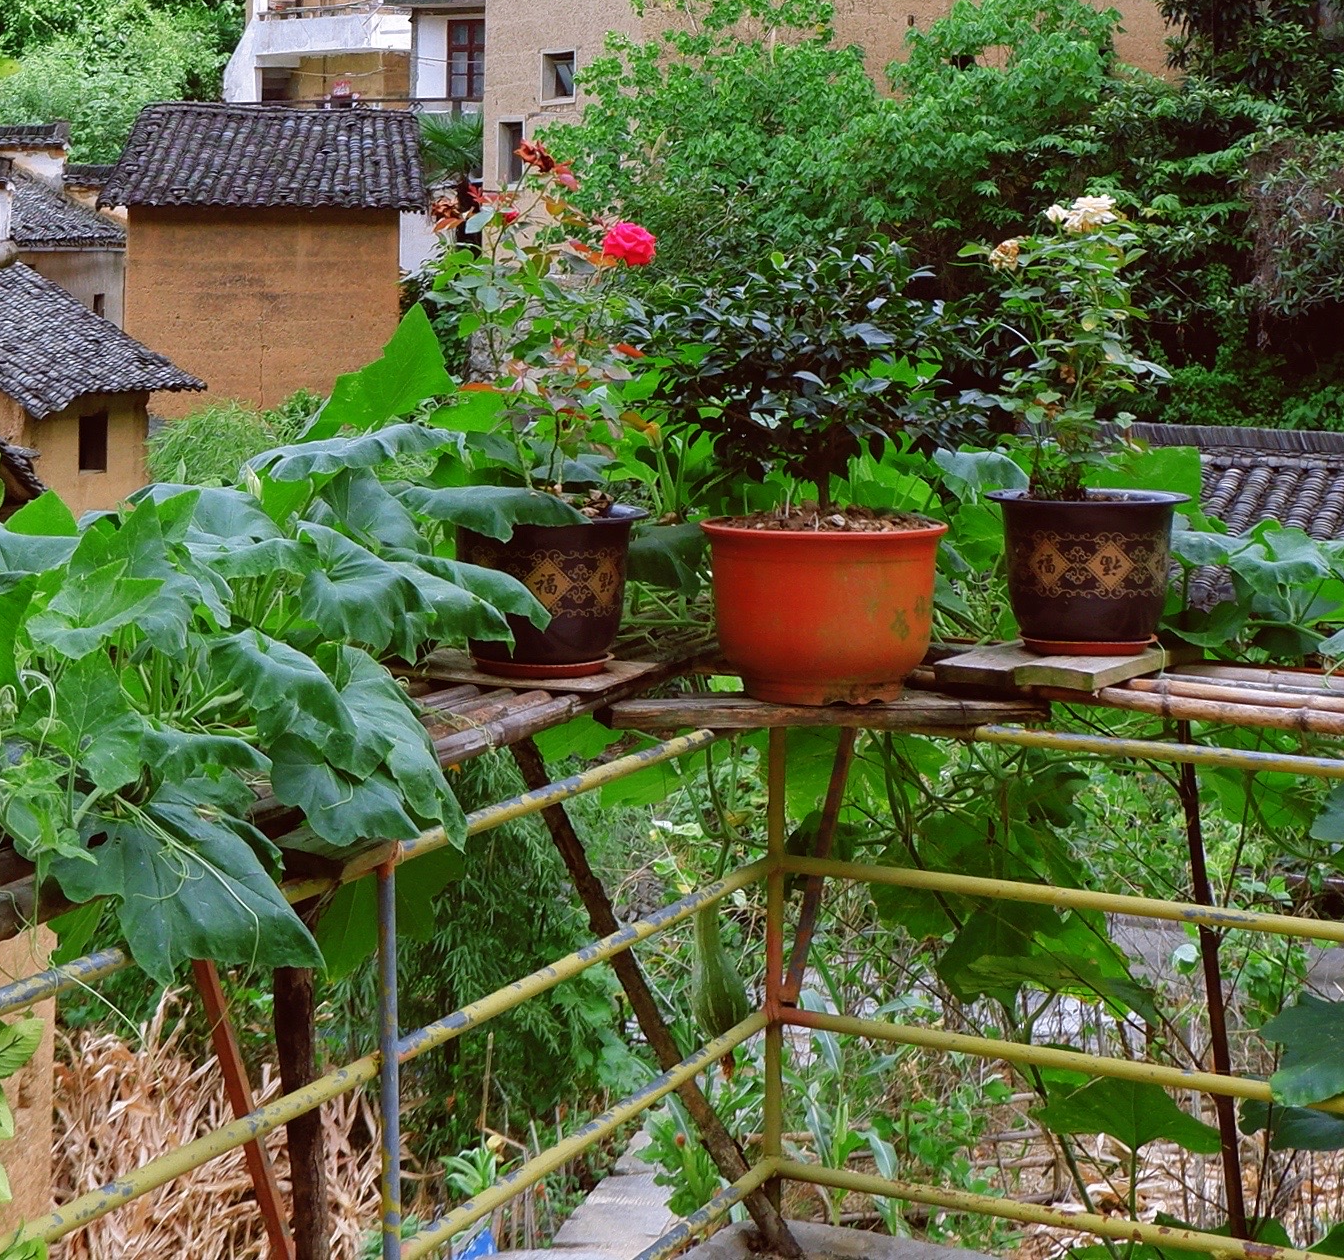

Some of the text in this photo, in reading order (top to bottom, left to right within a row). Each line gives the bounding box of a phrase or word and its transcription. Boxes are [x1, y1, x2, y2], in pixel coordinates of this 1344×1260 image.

[1036, 553, 1056, 575] 福
[1099, 555, 1122, 576] 福
[534, 573, 558, 596] 福
